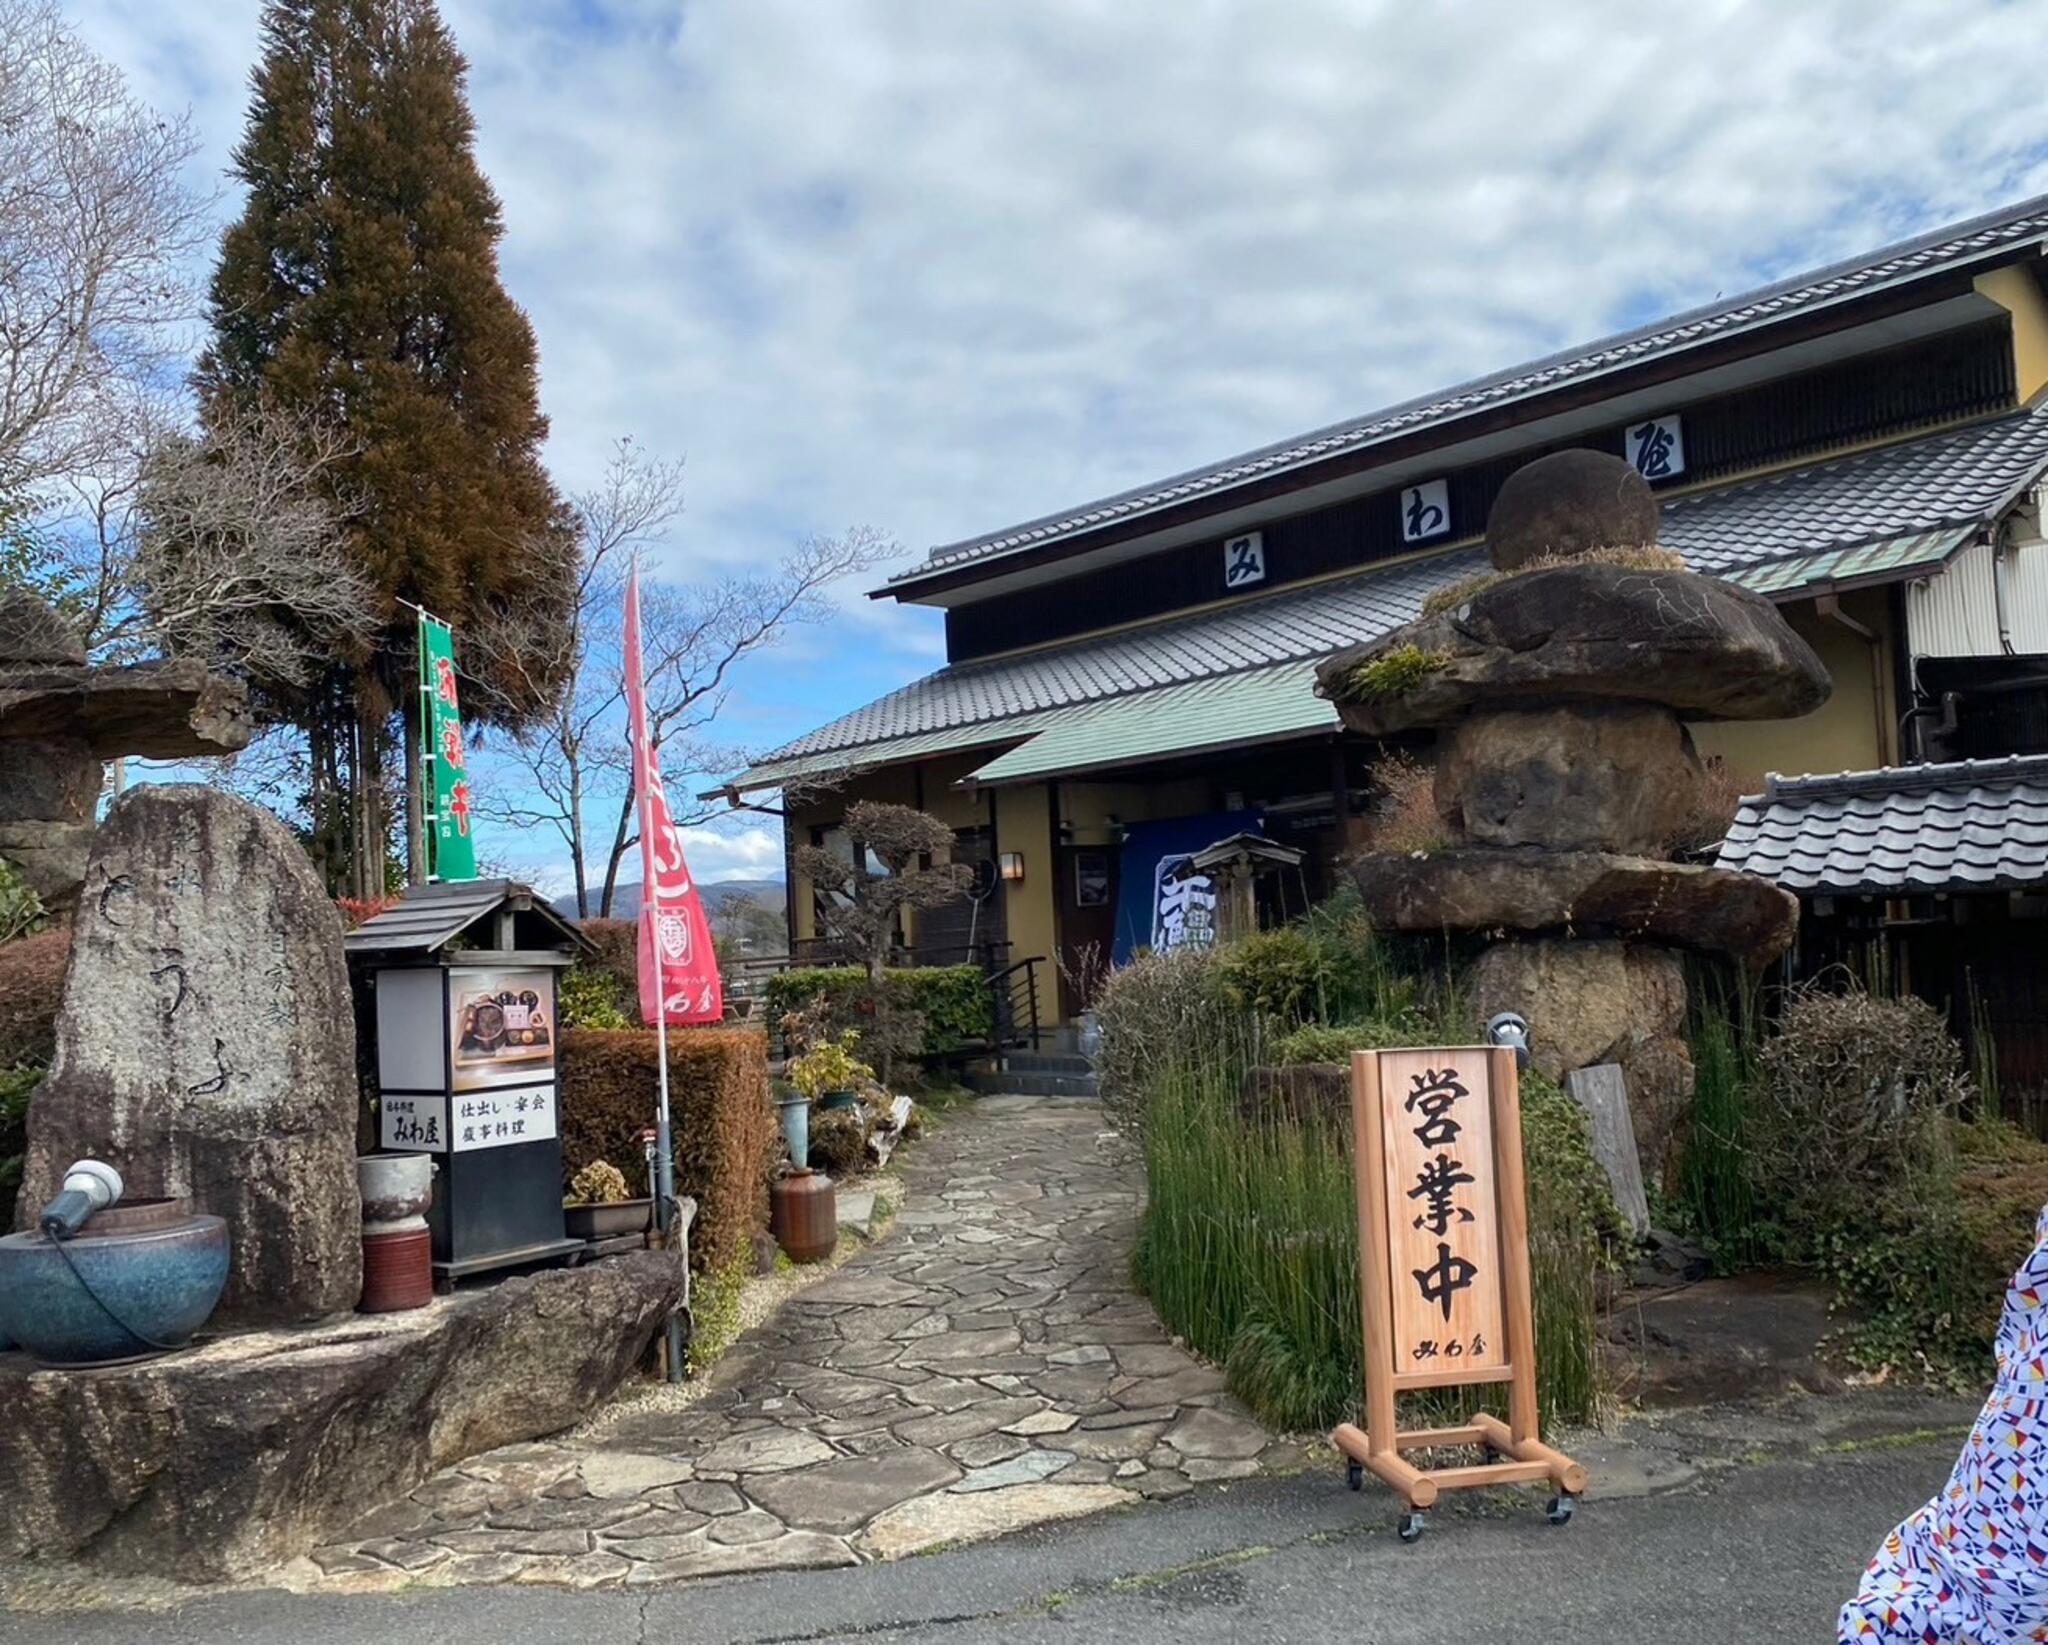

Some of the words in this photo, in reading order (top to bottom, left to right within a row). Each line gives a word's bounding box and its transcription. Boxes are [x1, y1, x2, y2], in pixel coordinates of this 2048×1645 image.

[394, 1116, 439, 1144] みわ屋
[1404, 1067, 1479, 1324] 営業中
[1412, 1333, 1488, 1360] みわ屋
